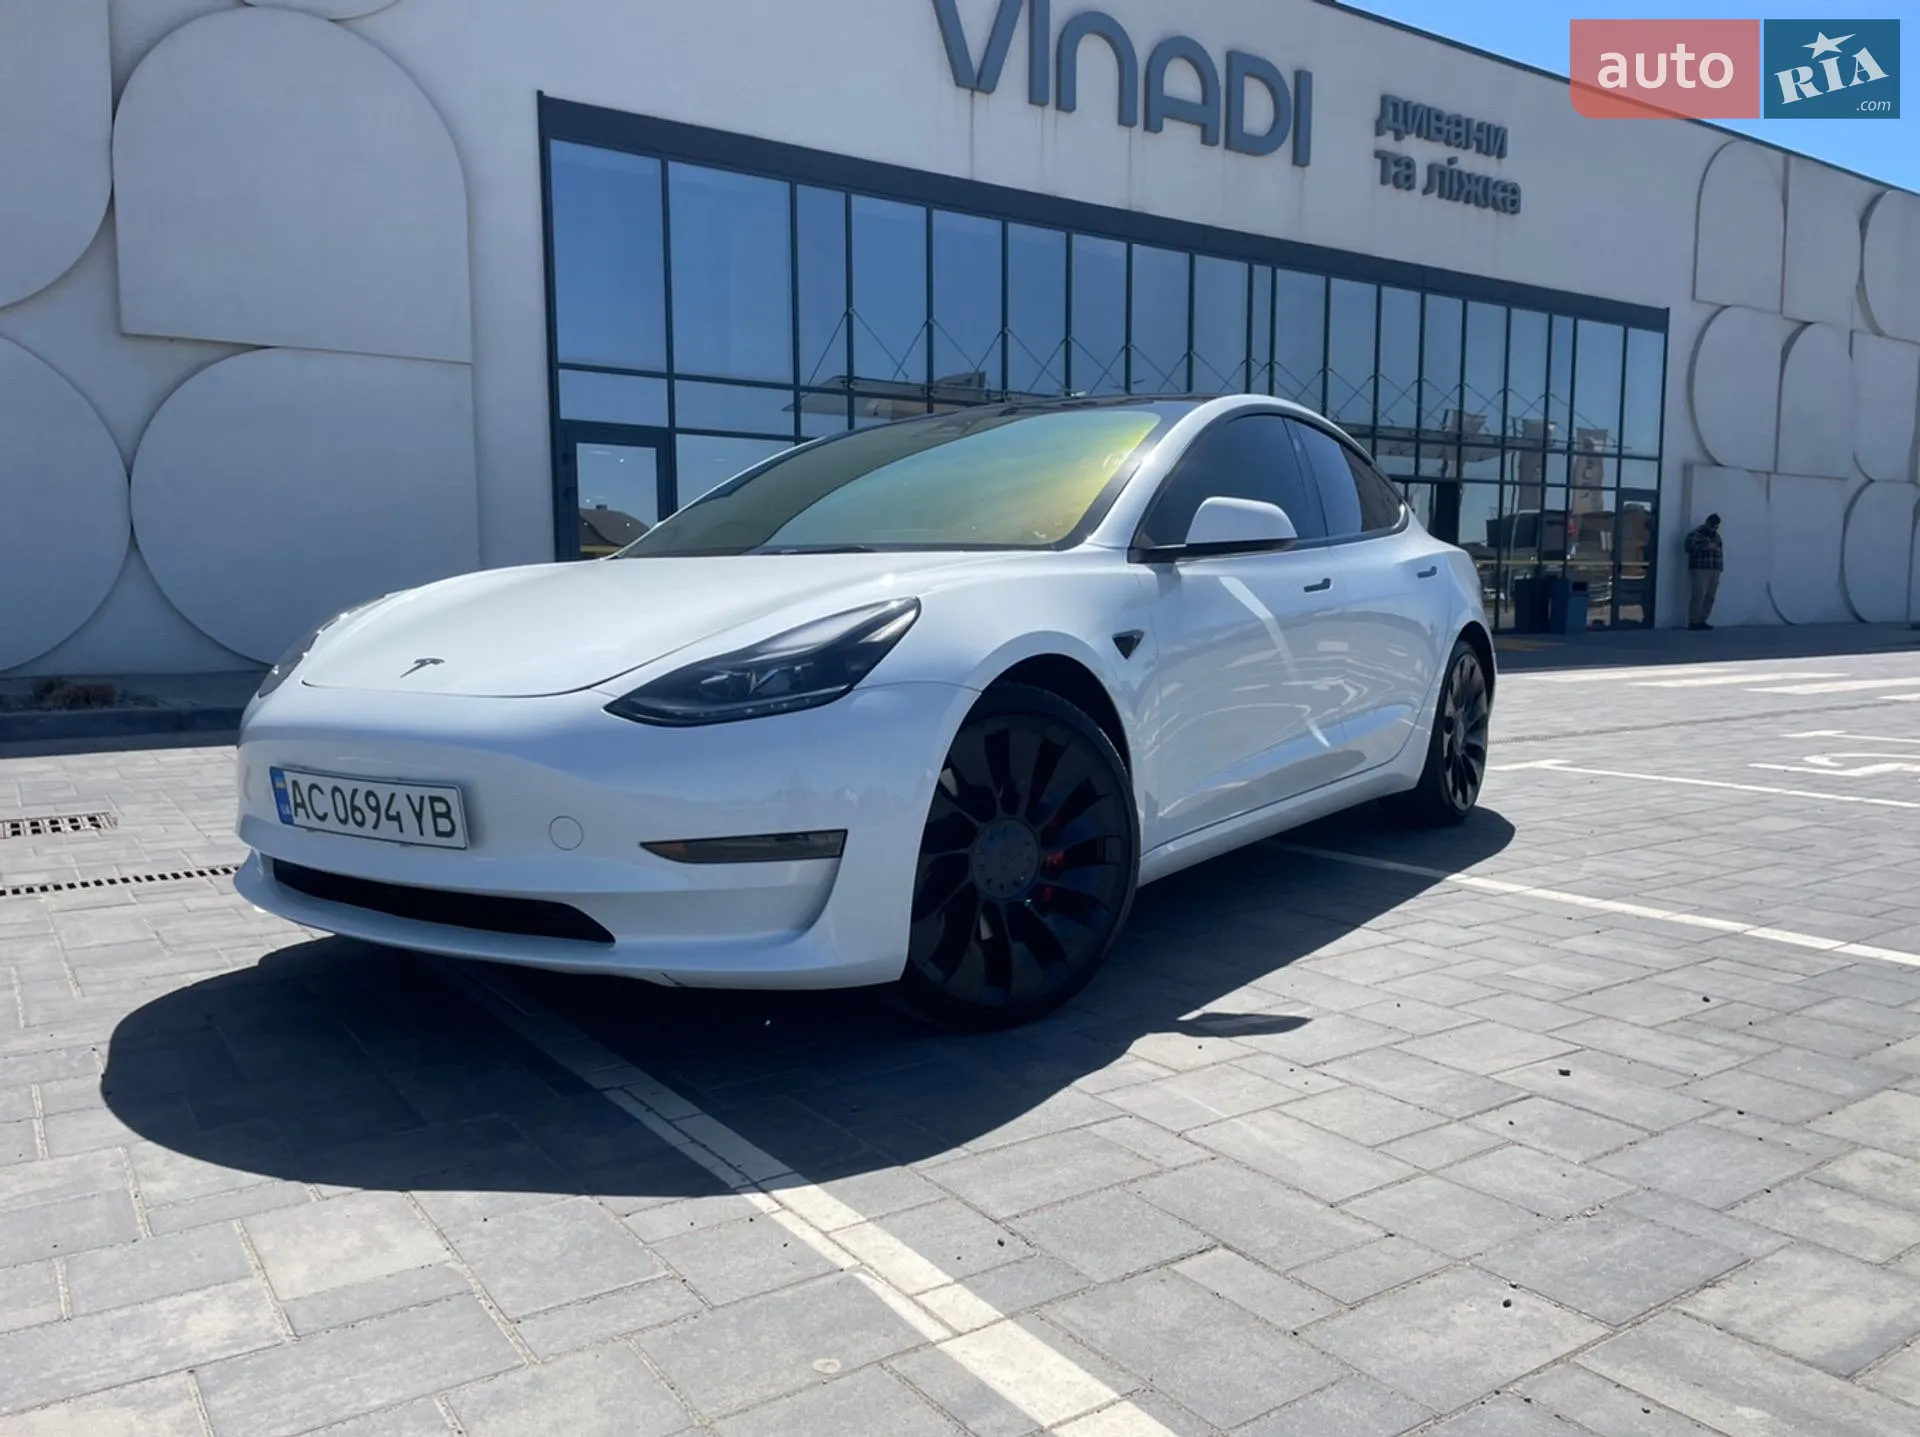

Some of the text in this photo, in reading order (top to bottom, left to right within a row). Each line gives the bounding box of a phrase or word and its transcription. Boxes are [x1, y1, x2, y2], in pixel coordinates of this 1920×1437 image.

[1375, 94, 1508, 159] дивани
[1374, 150, 1522, 215] та ліжка
